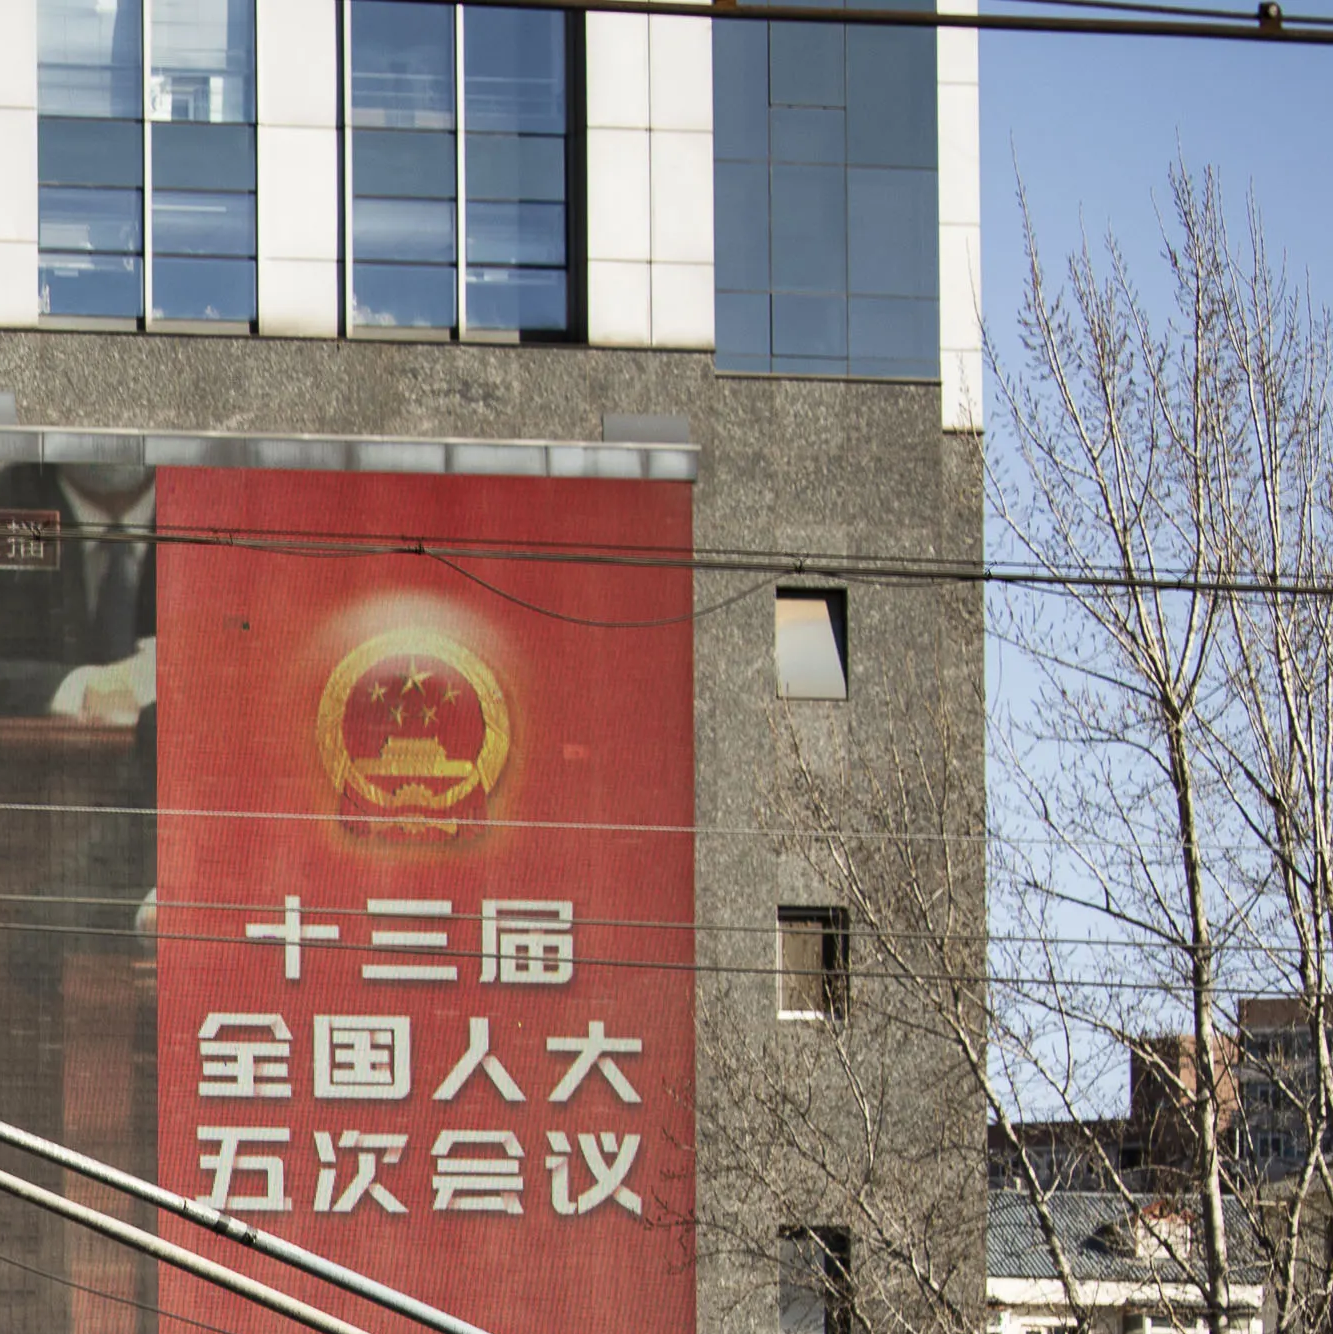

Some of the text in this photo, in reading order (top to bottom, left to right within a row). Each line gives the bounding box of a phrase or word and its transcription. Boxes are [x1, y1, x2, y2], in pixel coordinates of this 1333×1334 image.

[246, 895, 574, 983] 十三届
[198, 1013, 643, 1102] 全国人大
[196, 1126, 643, 1215] 五次会议
